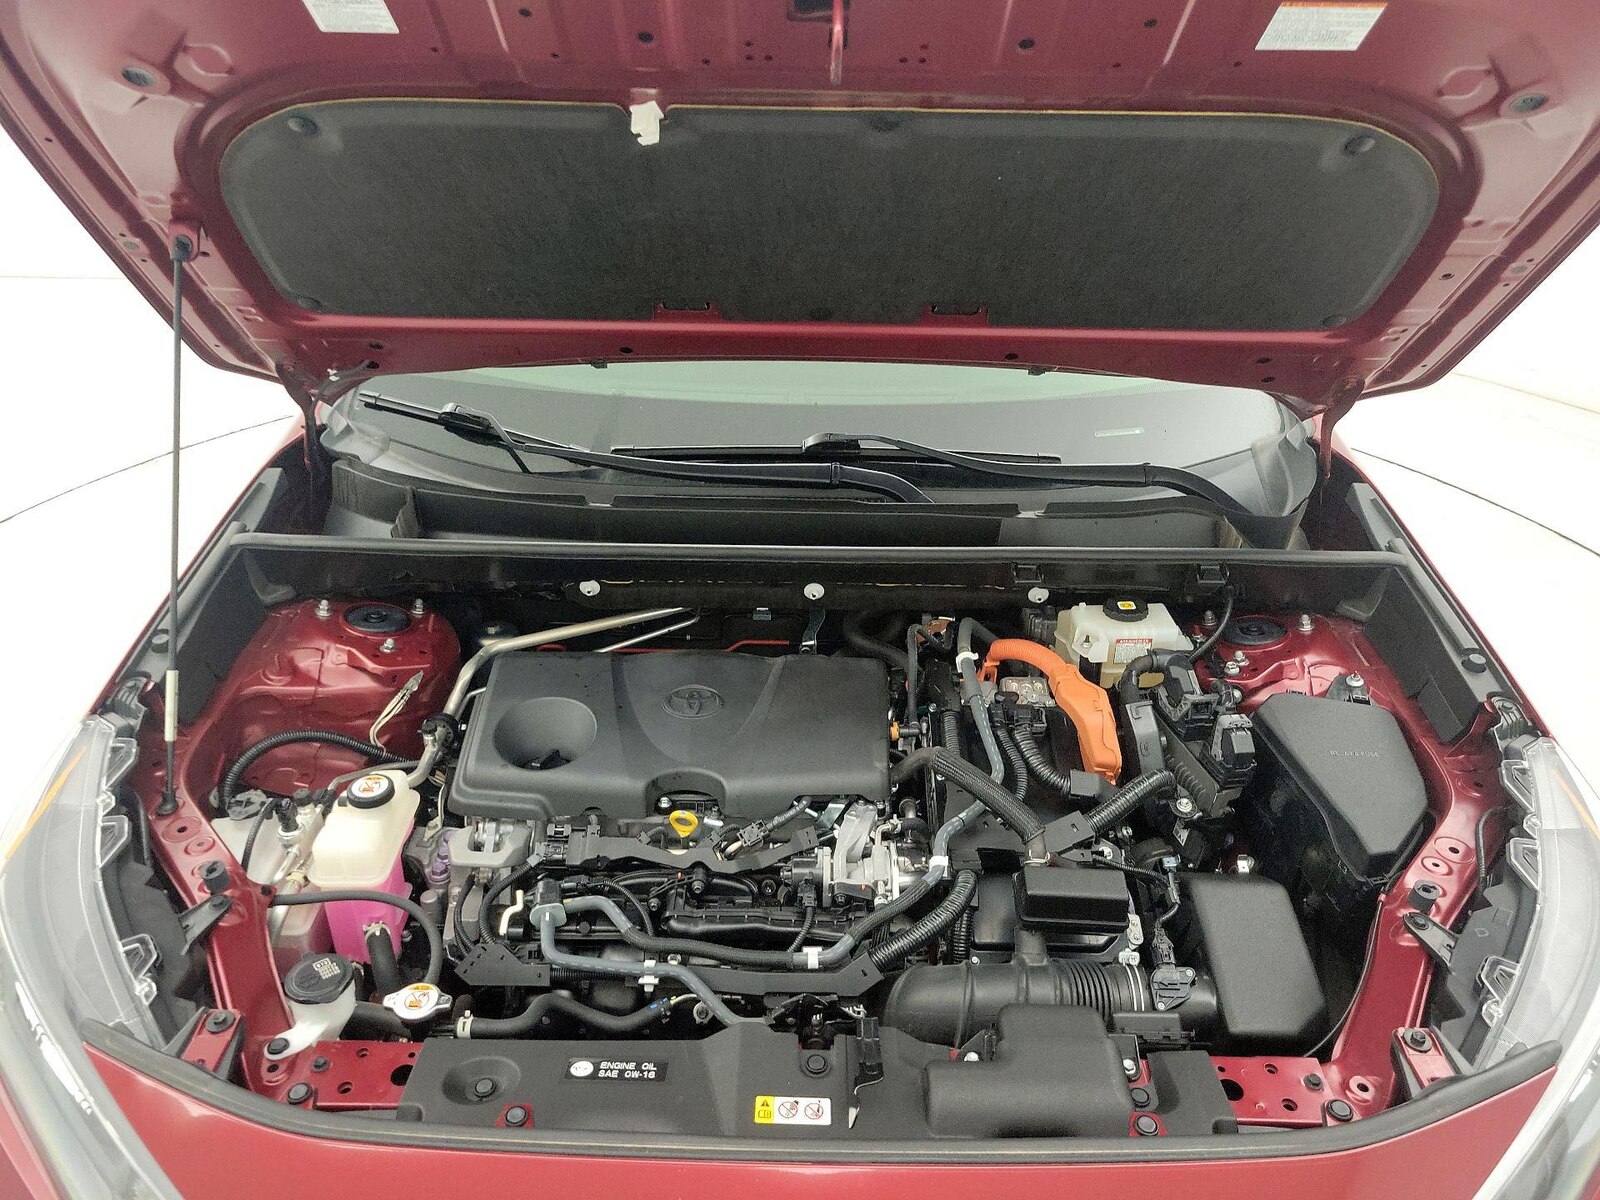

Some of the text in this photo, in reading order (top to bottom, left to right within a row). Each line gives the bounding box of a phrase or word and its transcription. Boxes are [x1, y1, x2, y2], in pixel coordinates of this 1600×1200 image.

[600, 1061, 657, 1071] ENGINE OIL
[598, 1069, 656, 1078] SAE 0W-16
